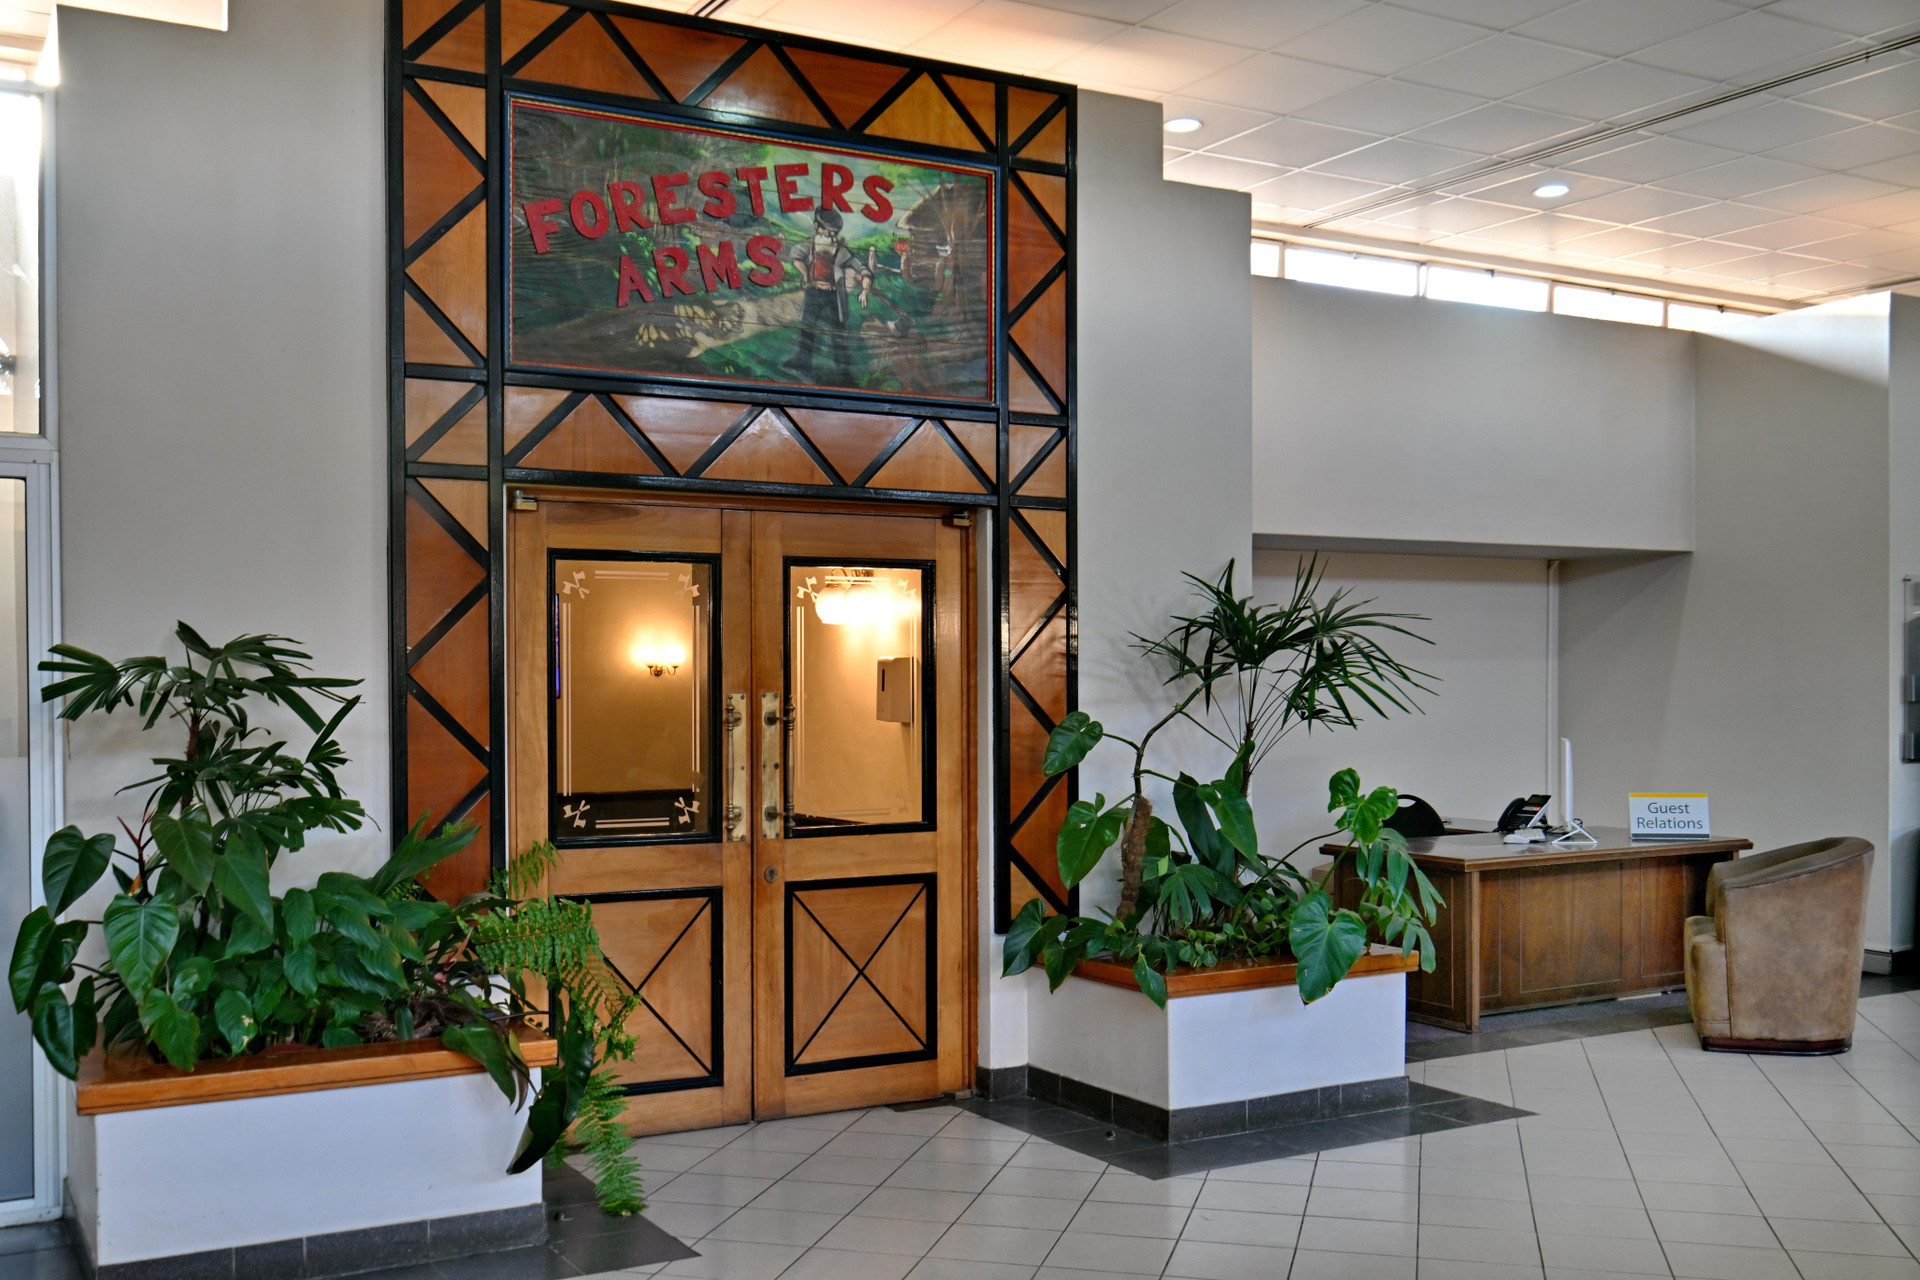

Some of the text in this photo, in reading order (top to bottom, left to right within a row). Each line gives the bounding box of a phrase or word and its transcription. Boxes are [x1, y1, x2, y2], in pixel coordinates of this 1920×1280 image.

[524, 162, 894, 254] FORESTERS
[617, 236, 785, 307] ARMS
[1636, 817, 1703, 829] Relations
[1647, 802, 1690, 814] Guest
